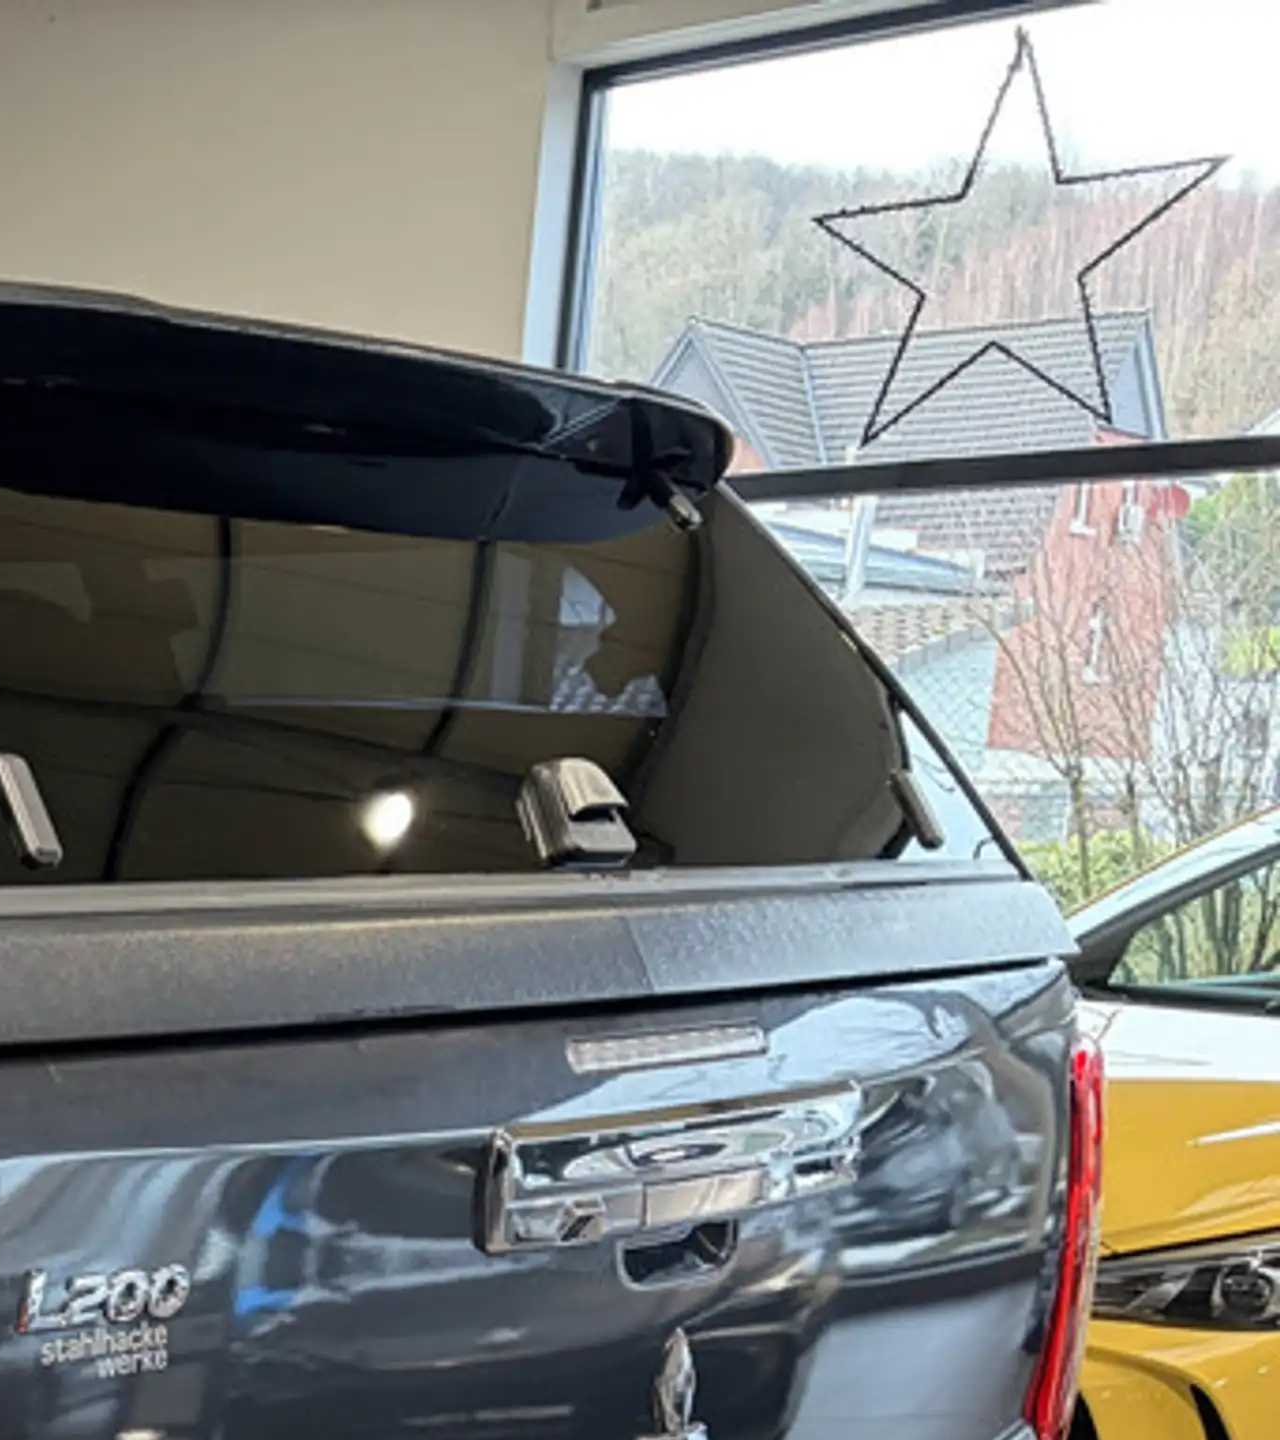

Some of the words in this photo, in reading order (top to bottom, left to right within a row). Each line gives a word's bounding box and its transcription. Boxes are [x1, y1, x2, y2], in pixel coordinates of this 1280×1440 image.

[16, 1263, 190, 1335] L200
[40, 1321, 169, 1366] stahlhacke
[95, 1347, 169, 1379] werke
